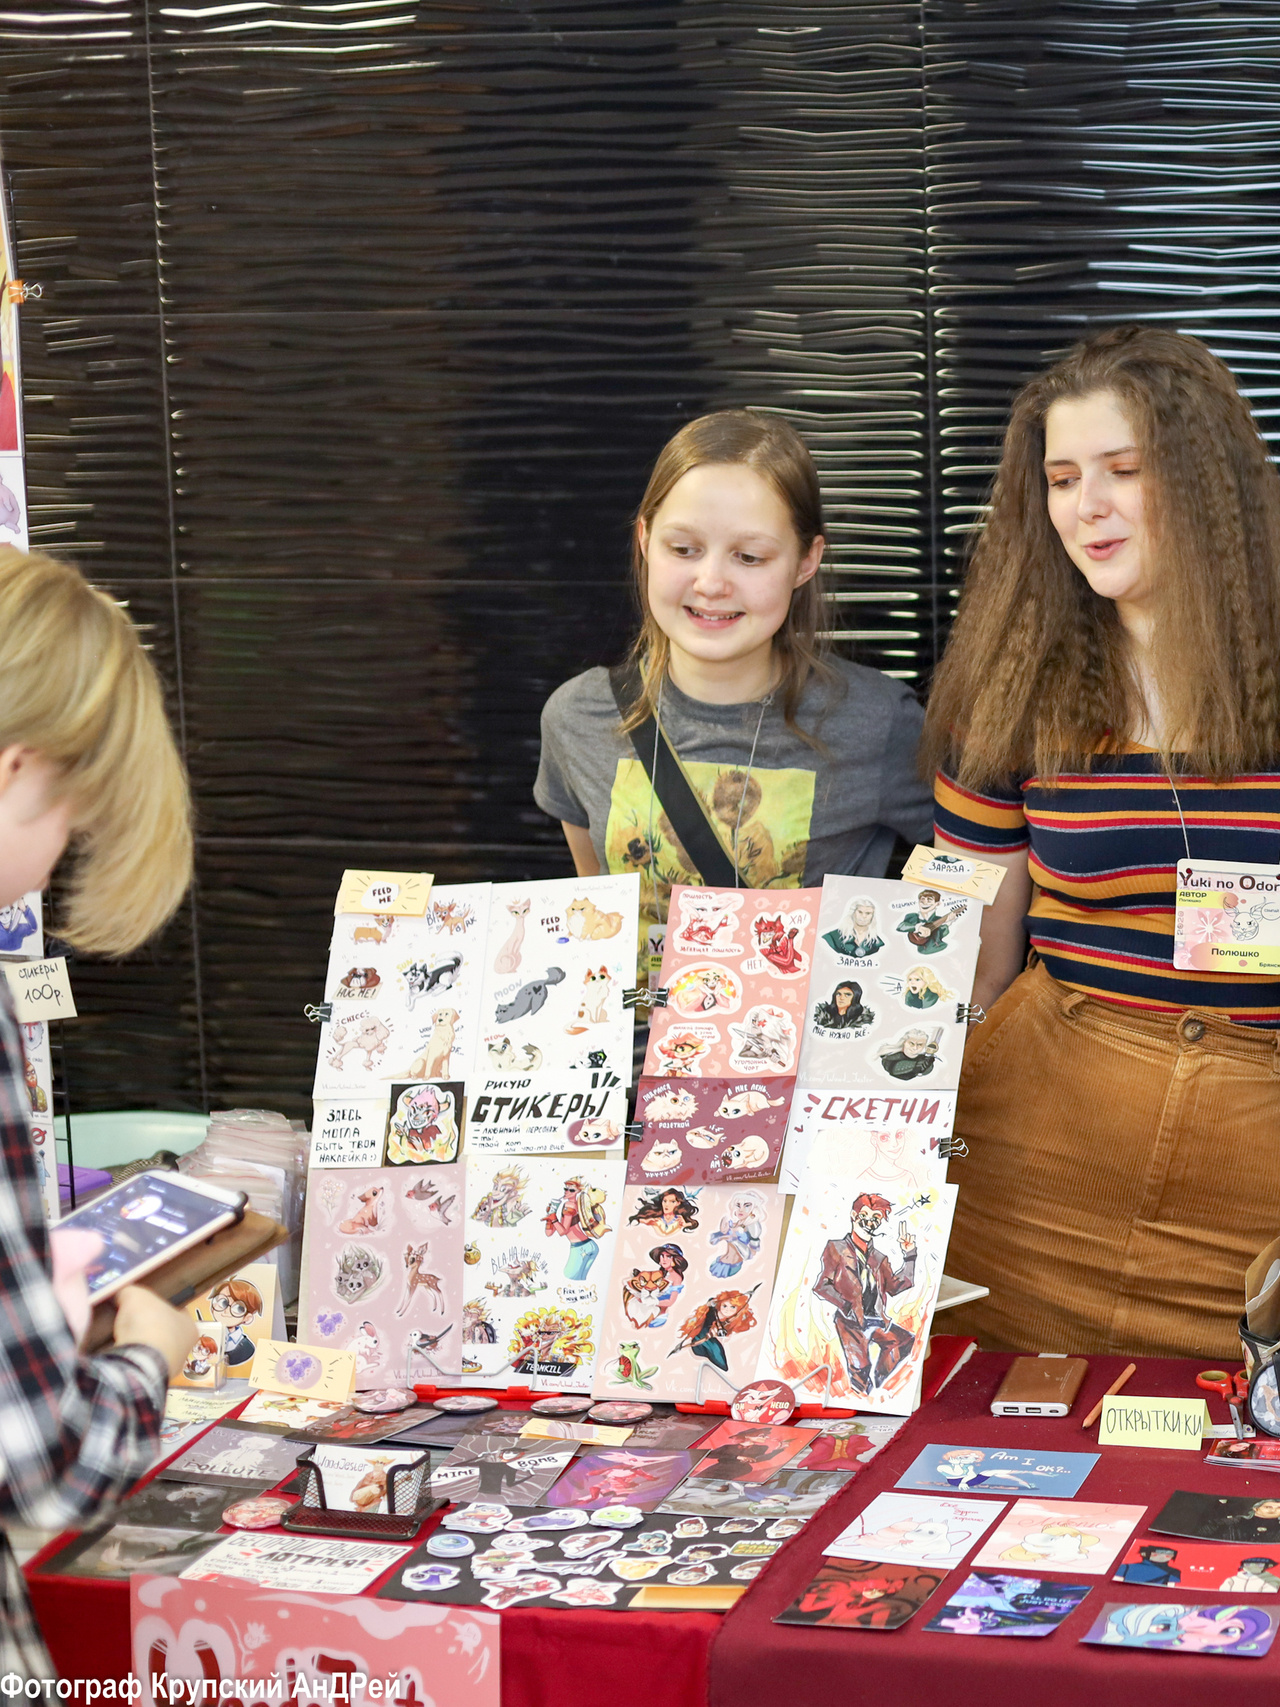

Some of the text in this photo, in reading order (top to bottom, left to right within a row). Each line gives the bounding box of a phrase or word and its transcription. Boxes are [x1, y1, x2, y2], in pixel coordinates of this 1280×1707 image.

[1179, 871, 1211, 888] Yuki
[1216, 879, 1234, 889] no
[372, 887, 392, 897] FEED
[541, 916, 561, 926] FEED
[1211, 948, 1260, 958] Полюшко
[336, 988, 377, 998] HUG ME!
[493, 979, 523, 1001] MOON
[812, 1026, 827, 1038] МНЕ
[829, 1030, 850, 1040] НУЖНО
[470, 1091, 610, 1124] СТИКЕРЫ
[821, 1096, 940, 1125] СКЕТЧИ
[326, 1109, 362, 1122] ЗДЕСЬ
[322, 1127, 360, 1139] МОГЛА
[350, 1139, 376, 1149] ТВОЯ
[517, 1455, 559, 1467] BOMB
[990, 1451, 1035, 1466] Am I
[184, 1460, 273, 1478] POLLUTE
[436, 1468, 476, 1479] MIME
[255, 1551, 371, 1569] ЛОТЕРЕЯ!
